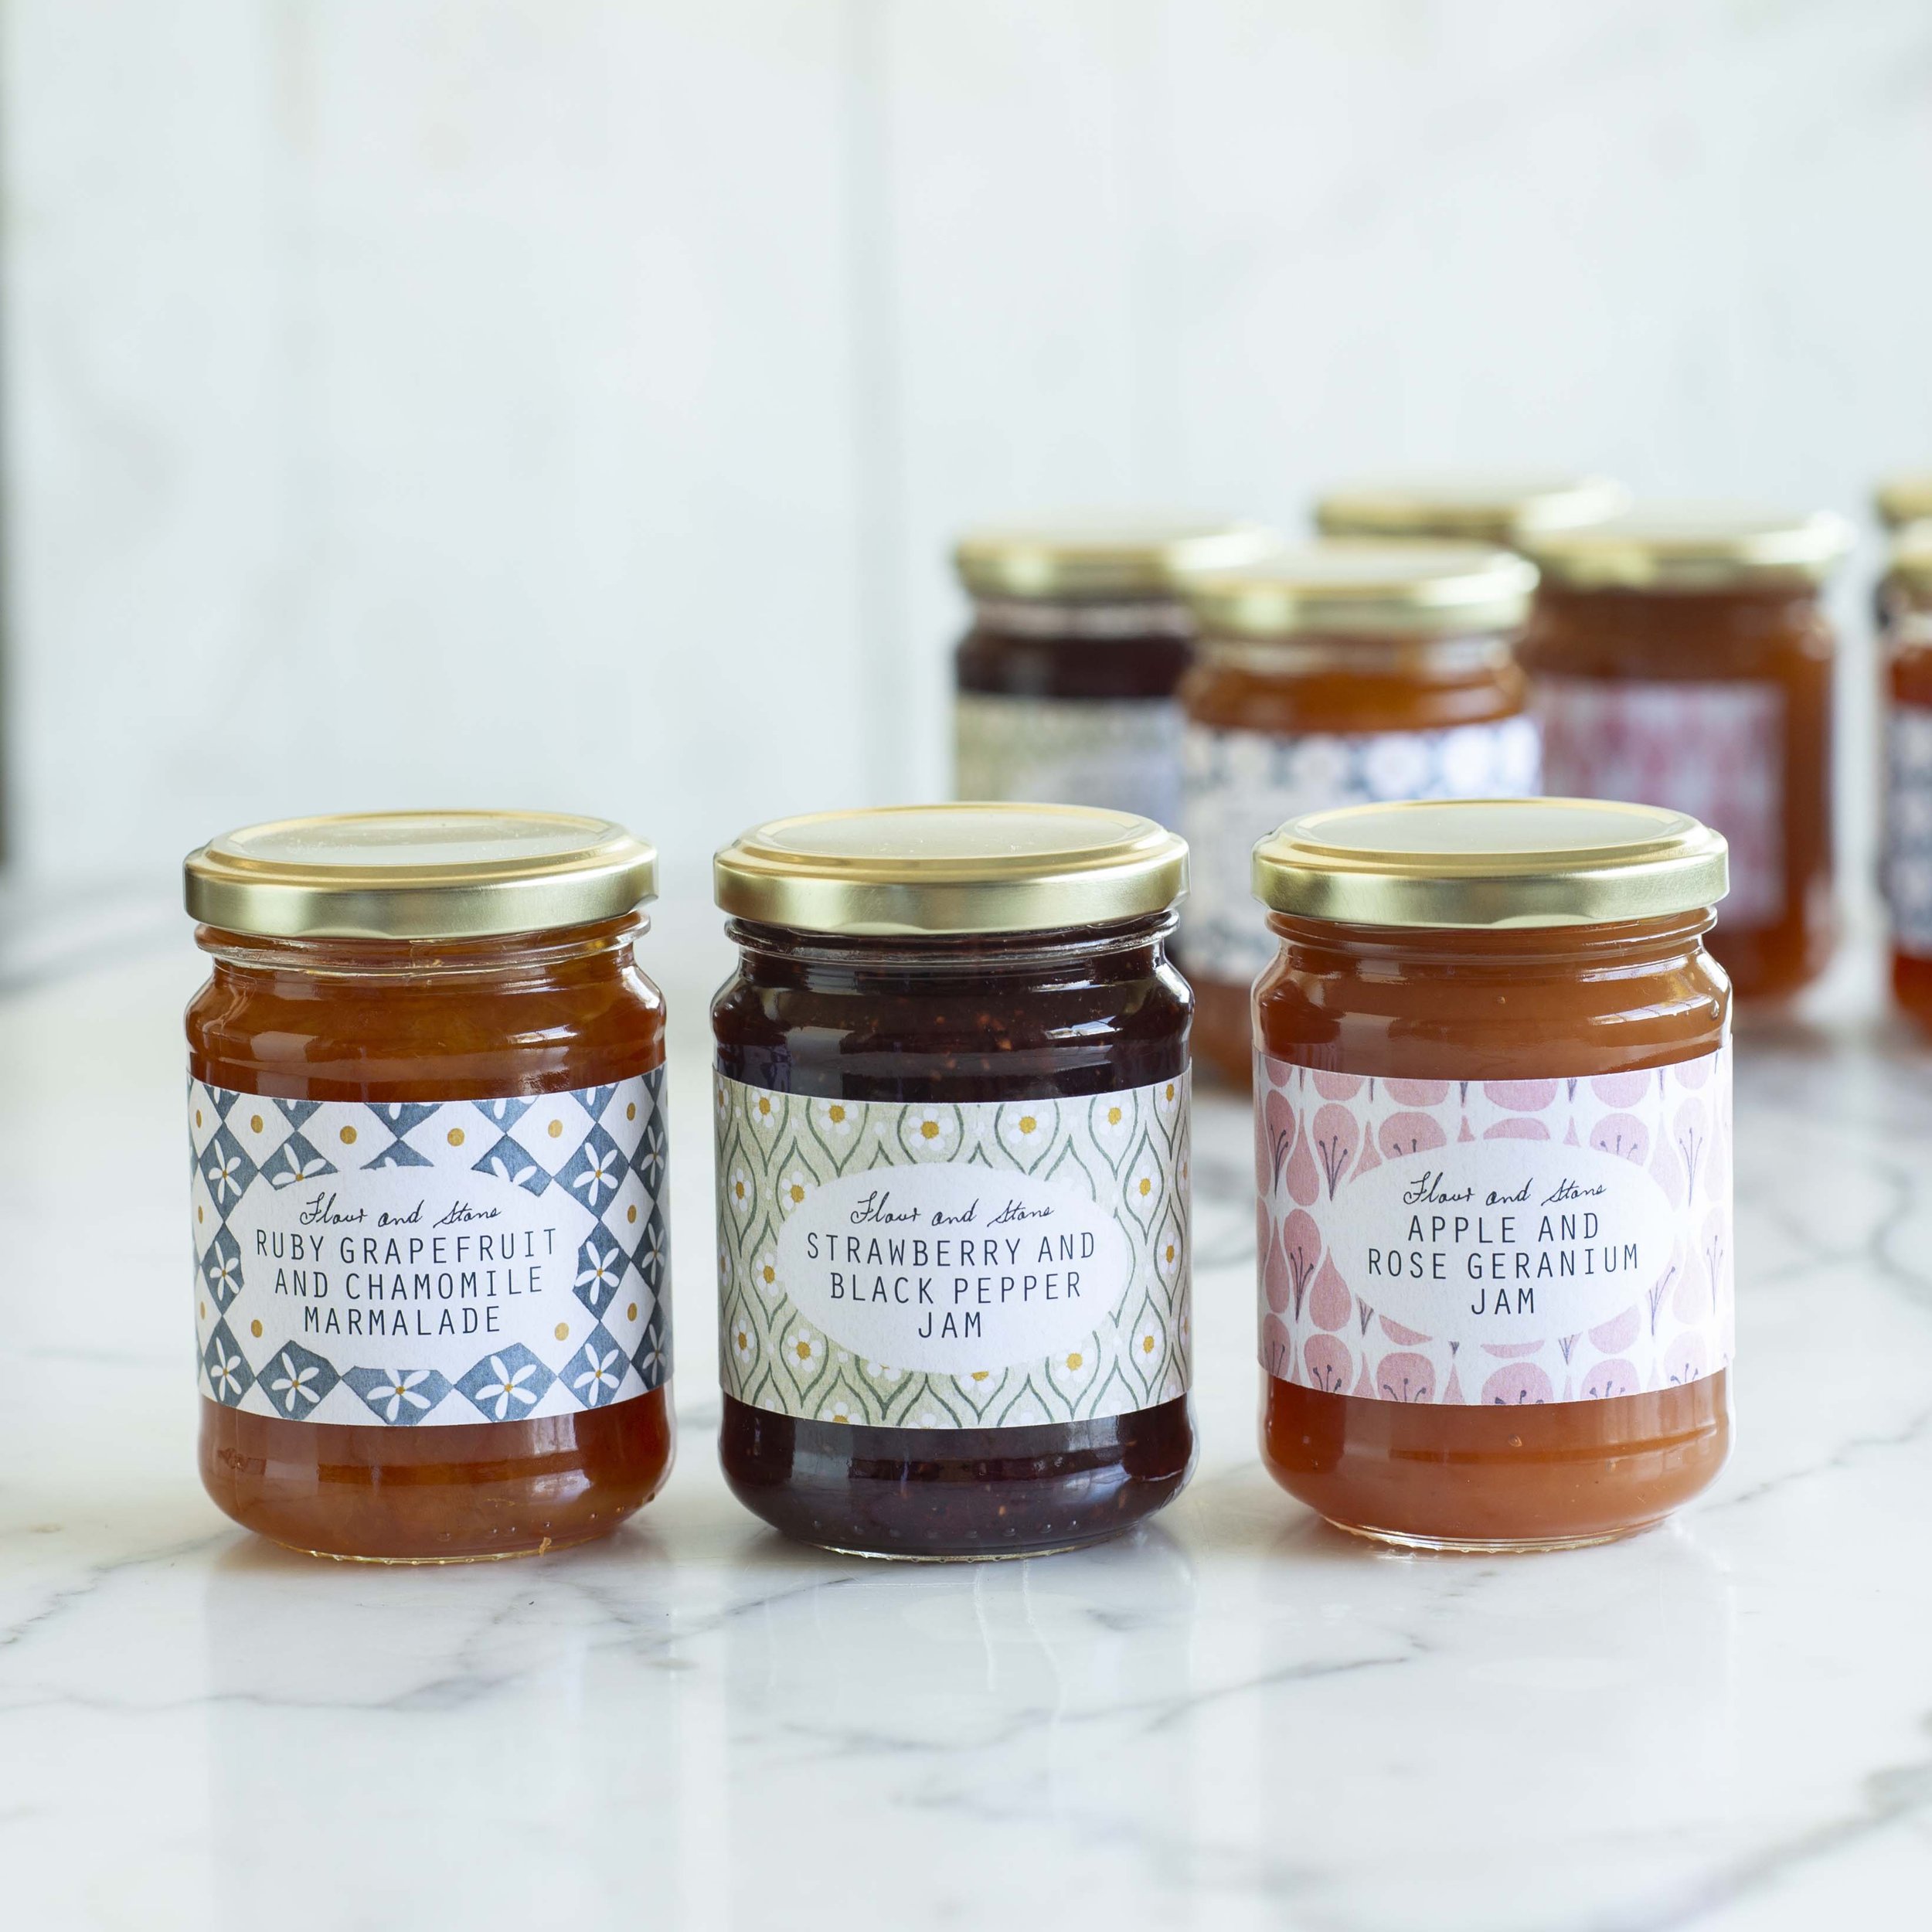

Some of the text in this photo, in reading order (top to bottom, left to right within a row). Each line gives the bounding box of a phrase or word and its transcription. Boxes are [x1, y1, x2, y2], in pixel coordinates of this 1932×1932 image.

[1403, 1171, 1606, 1206] Flour and Stone
[300, 1192, 501, 1228] Flour and Stone
[850, 1191, 1053, 1227] Flour and Stone
[1408, 1213, 1597, 1243] APPLE AND
[257, 1229, 555, 1264] RUBY GRAPEFRUIT
[808, 1233, 1094, 1266] STRAWBERRY AND
[1369, 1244, 1637, 1279] ROSE GERANIUM
[275, 1266, 542, 1300] AND CHAMOMILE
[831, 1272, 1080, 1304] BLACK PEPPER
[1471, 1288, 1533, 1315] JAM
[305, 1306, 499, 1335] MARMALADE
[919, 1312, 981, 1338] JAM
